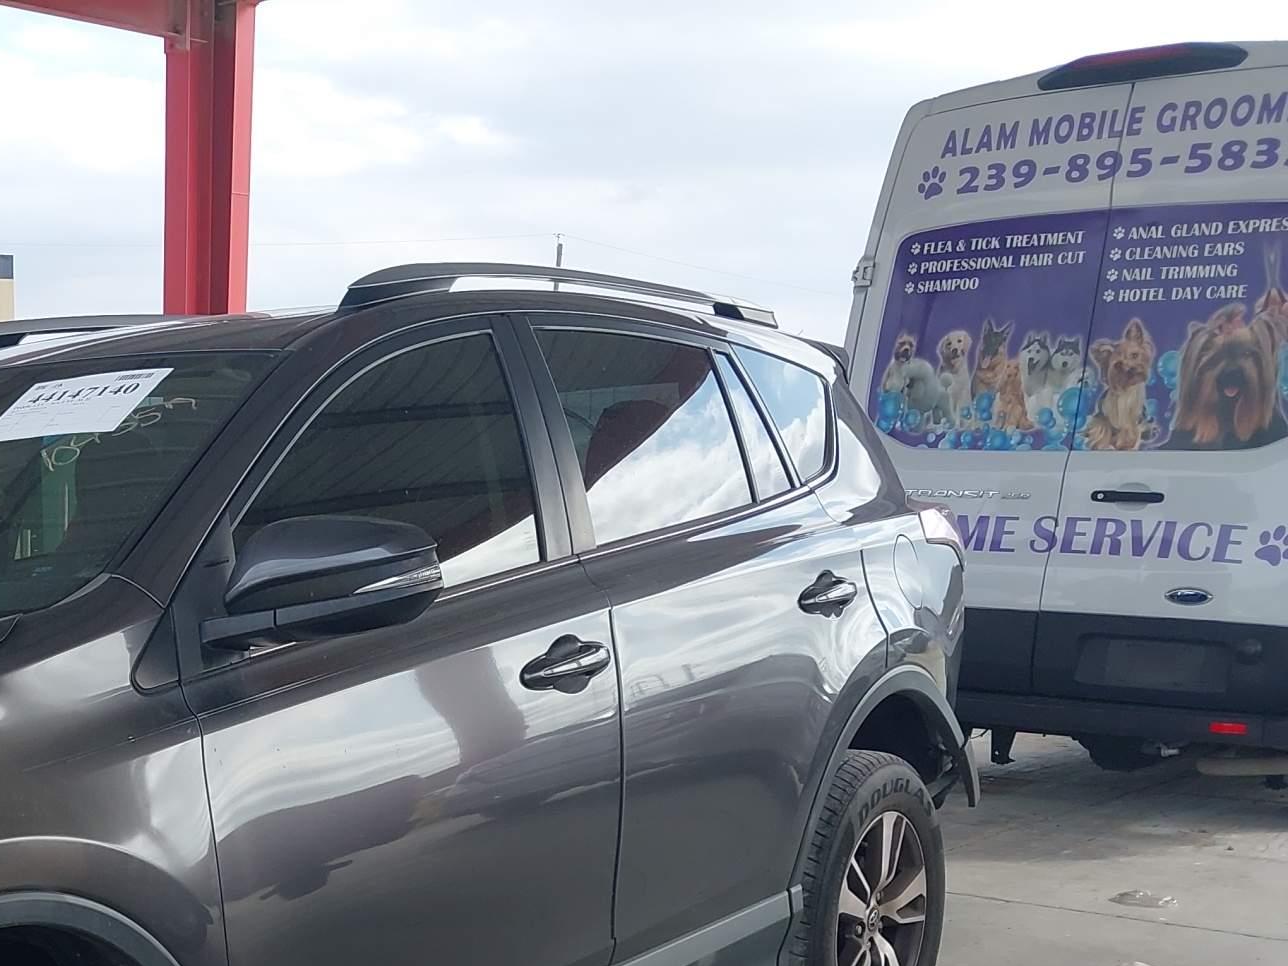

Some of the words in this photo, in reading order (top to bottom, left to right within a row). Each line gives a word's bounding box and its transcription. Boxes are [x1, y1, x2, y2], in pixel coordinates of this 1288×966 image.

[941, 121, 1020, 159] ALAM
[1029, 106, 1146, 147] MOBILE
[1156, 91, 1288, 134] GROOM
[956, 137, 1288, 195] 239-895-583
[1128, 226, 1165, 239] ANAL
[1171, 222, 1223, 237] GLAND
[923, 242, 952, 254] FLEA
[956, 240, 966, 251] &
[971, 236, 1001, 250] TICK
[1005, 231, 1086, 249] TREATMENT
[1125, 244, 1199, 261] CLEANING
[1203, 241, 1245, 257] EARS
[920, 256, 1015, 274] PROFESSIONAL
[1020, 252, 1053, 267] HAIR
[1057, 251, 1086, 264] CUT
[1121, 268, 1155, 281] NAIL
[1160, 264, 1238, 280] TRIMMING
[917, 277, 979, 293] SHAMPOO
[1118, 287, 1166, 302] HOTEL
[1171, 286, 1202, 300] DAY
[1206, 285, 1249, 298] CARE
[27, 383, 140, 404] 44147140
[1030, 515, 1249, 564] SERVICE
